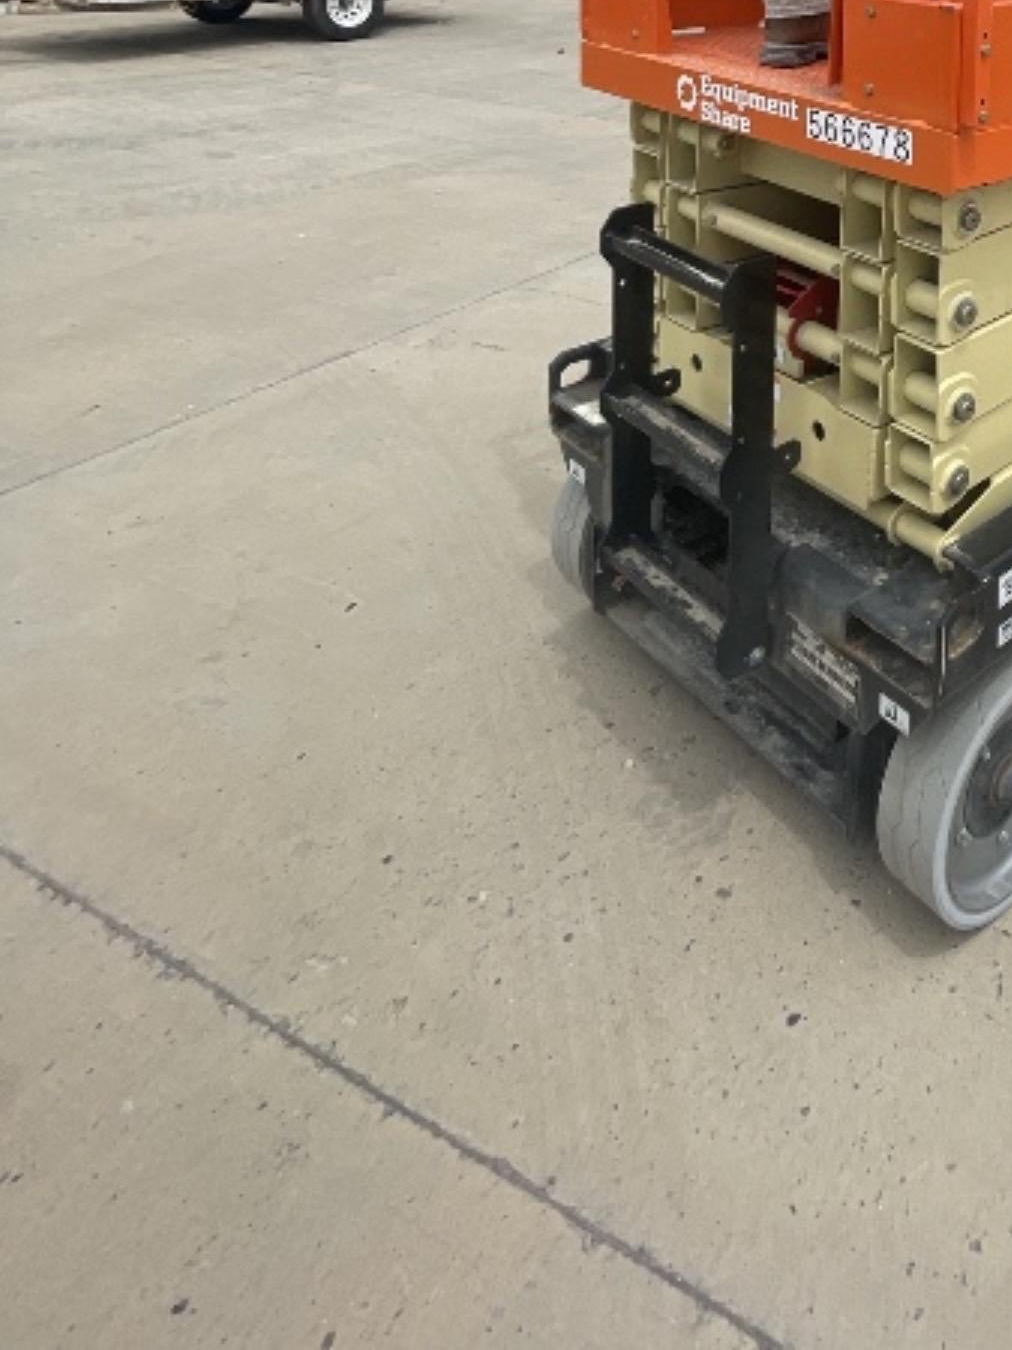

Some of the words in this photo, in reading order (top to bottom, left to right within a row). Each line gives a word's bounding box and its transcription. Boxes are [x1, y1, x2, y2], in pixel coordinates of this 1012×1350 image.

[701, 75, 799, 121] Equipment
[701, 100, 751, 134] Share
[809, 109, 911, 163] 566678
